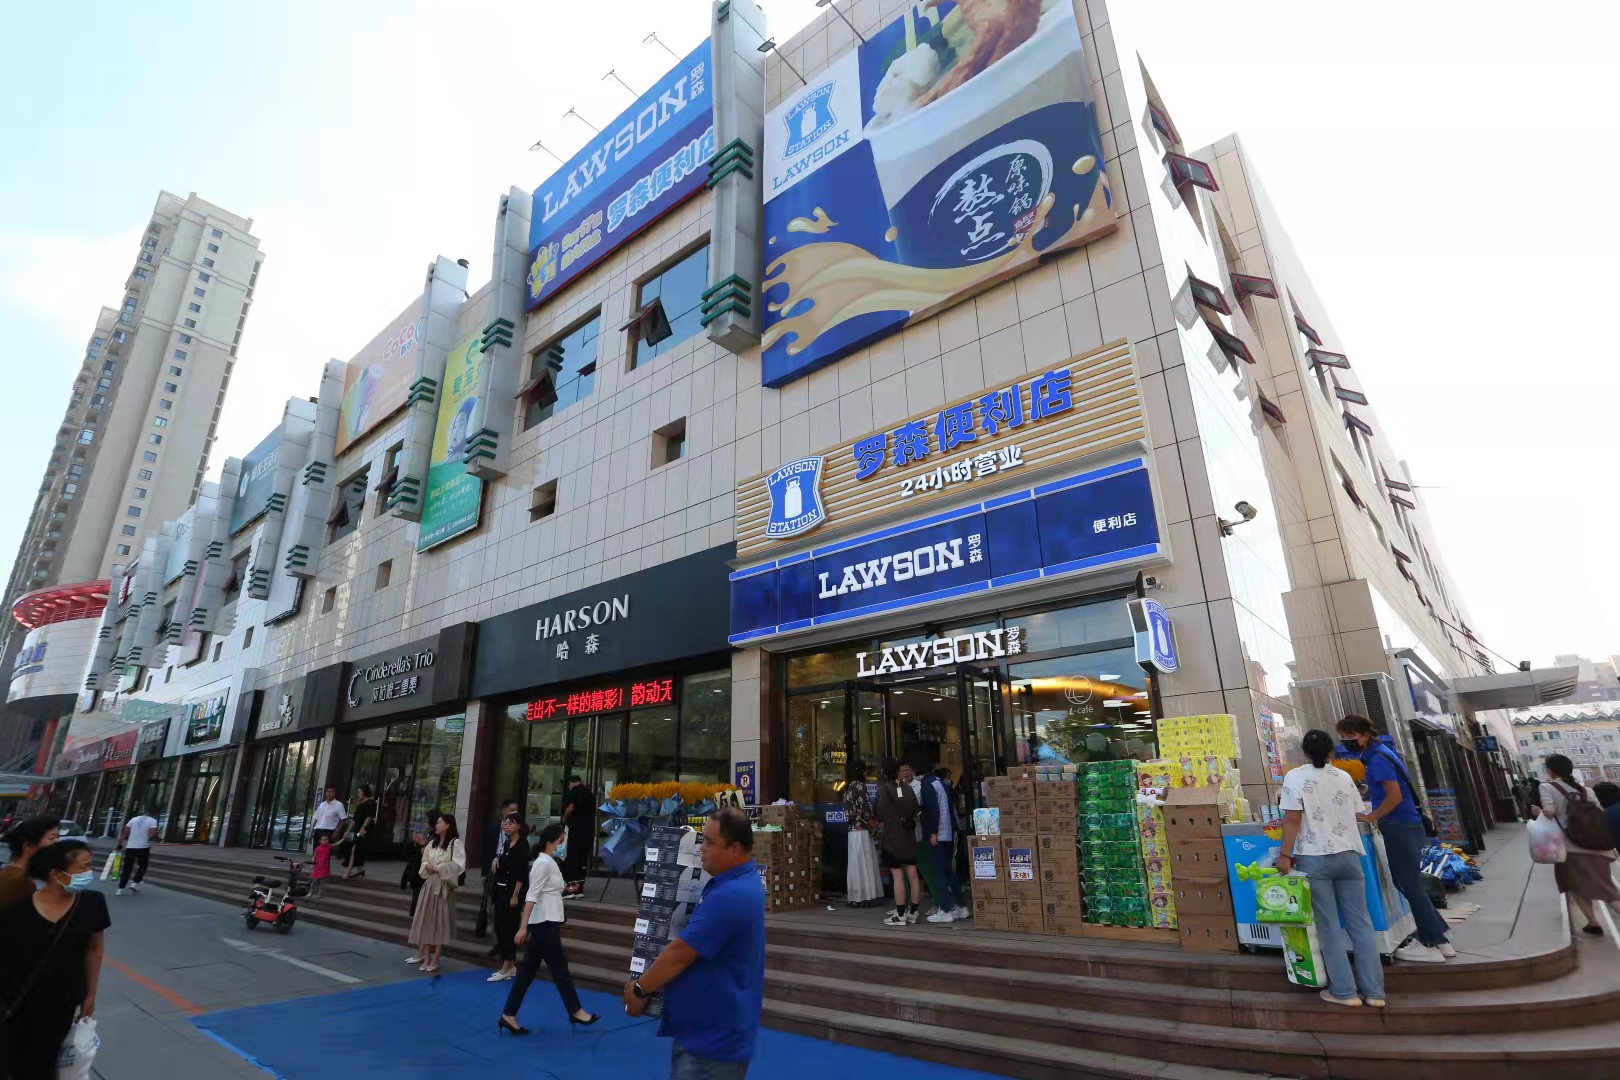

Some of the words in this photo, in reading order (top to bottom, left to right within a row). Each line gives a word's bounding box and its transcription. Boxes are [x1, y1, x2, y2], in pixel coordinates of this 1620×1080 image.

[690, 61, 705, 101] 罗森
[787, 86, 831, 121] LAWSON
[542, 75, 688, 224] LAWSON
[787, 120, 832, 155] STATION
[772, 128, 850, 191] LAWSON
[853, 368, 1074, 481] 罗森便利店
[768, 460, 818, 487] LAWSON
[900, 444, 1024, 498] 24小时营业
[768, 508, 818, 534] STATION
[1092, 511, 1138, 534] 便利店
[967, 533, 983, 564] 罗森
[818, 537, 965, 600] LAWSON
[535, 593, 630, 641] HARSON
[856, 628, 1006, 678] LAWSON
[1006, 625, 1022, 656] 罗森
[365, 655, 412, 683] Cinderella's
[414, 648, 434, 669] Trio
[1069, 706, 1094, 716] L-café
